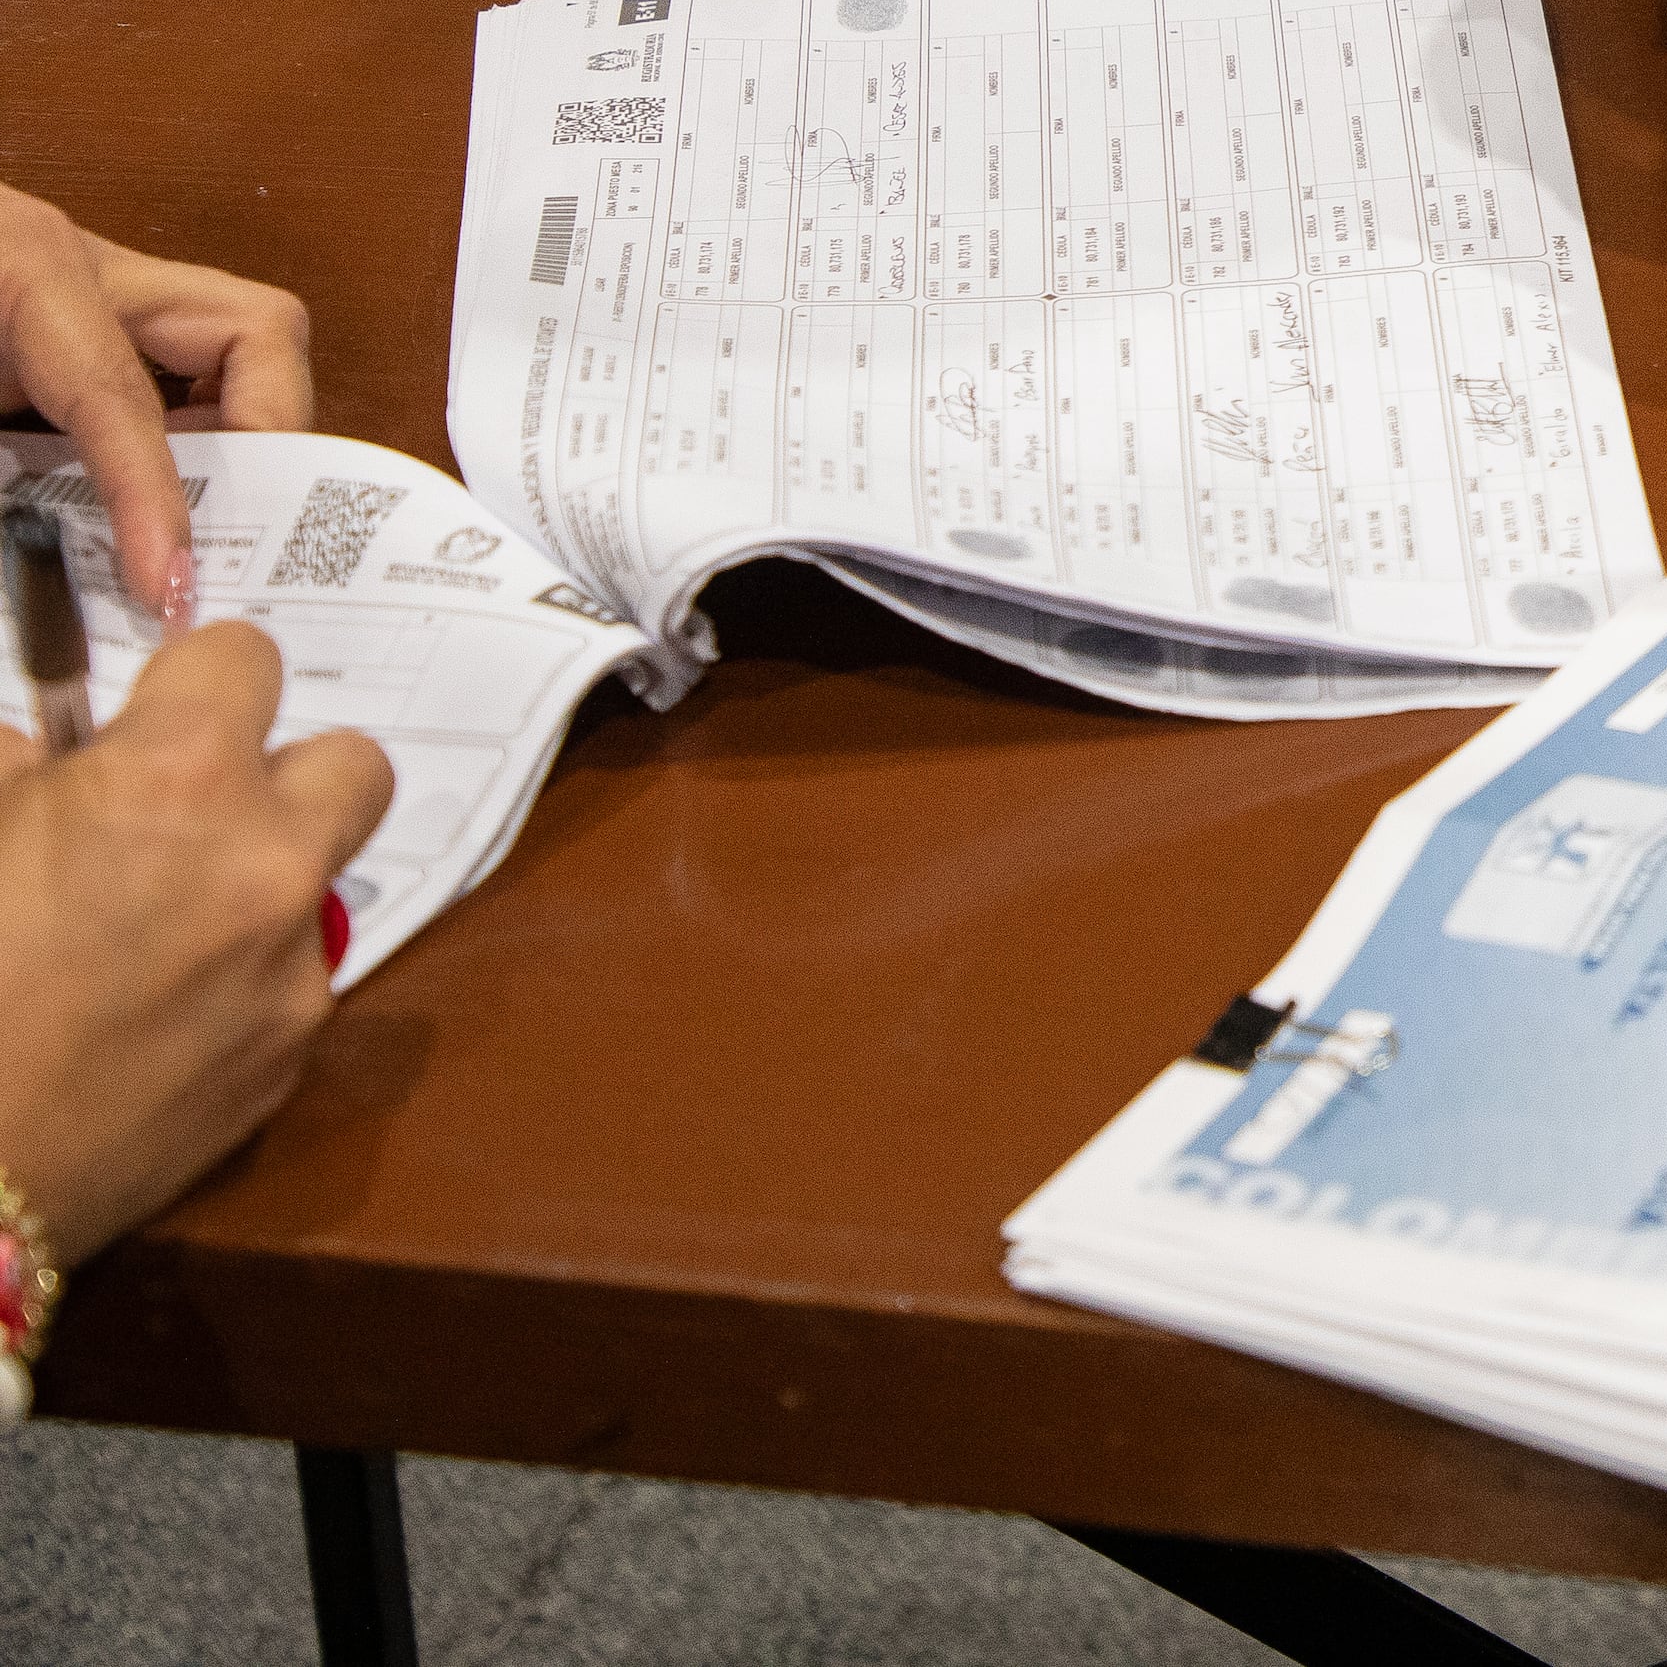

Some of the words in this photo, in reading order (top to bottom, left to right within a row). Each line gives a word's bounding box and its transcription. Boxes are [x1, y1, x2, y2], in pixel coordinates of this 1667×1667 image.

[1342, 42, 1354, 67] NOMBRES
[1457, 32, 1470, 57] NOMBRES
[1108, 64, 1119, 89] NOMBRES
[1226, 55, 1237, 80] NOMBRES
[743, 78, 755, 105] NOMBRES
[867, 78, 878, 104] NOMBRES
[988, 72, 999, 96] NOMBRES
[1412, 86, 1422, 103] FIRMA
[1175, 110, 1185, 127] FIRMA
[1294, 98, 1304, 115] FIRMA
[1470, 104, 1482, 131] APELLIDO
[931, 126, 942, 142] FIRMA
[1054, 118, 1064, 134] FIRMA
[1352, 115, 1364, 142] APELLIDO
[681, 132, 693, 150] FIRMA
[807, 130, 818, 148] FIRMA
[1111, 138, 1122, 165] APELLIDO
[1232, 128, 1244, 154] APELLIDO
[1474, 131, 1487, 159] SEGUNDO
[988, 145, 999, 172] APELLIDO
[1235, 154, 1246, 182] SEGUNDO
[1355, 142, 1367, 170] SEGUNDO
[609, 161, 622, 177] MESA
[737, 155, 750, 183] APELLIDO
[1112, 165, 1124, 192] SEGUNDO
[607, 177, 620, 201] PUESTO
[735, 183, 748, 209] SEGUNDO
[863, 180, 874, 206] SEGUNDO
[989, 173, 999, 199] SEGUNDO
[604, 202, 617, 217] ZONA
[1362, 199, 1374, 228] APELLIDO
[1427, 203, 1440, 226] CÉDULA
[1483, 189, 1497, 216] APELLIDO
[1114, 222, 1126, 249] APELLIDO
[1180, 226, 1193, 249] CÉDULA
[1239, 211, 1251, 239] APELLIDO
[1305, 214, 1318, 238] CÉDULA
[1488, 217, 1500, 240] PRIMER
[730, 238, 743, 264] APELLIDO
[860, 234, 872, 261] APELLIDO
[989, 229, 1000, 256] APELLIDO
[1055, 235, 1067, 258] CÉDULA
[1241, 239, 1253, 263] PRIMER
[1365, 228, 1377, 251] PRIMER
[1552, 235, 1571, 266] 115,964
[668, 247, 681, 269] CÉDULA
[799, 245, 812, 267] CÉDULA
[928, 242, 940, 264] CÉDULA
[1116, 250, 1127, 272] PRIMER
[728, 264, 741, 285] PRIMER
[859, 262, 871, 283] PRIMER
[989, 257, 1000, 279] PRIMER
[1558, 269, 1574, 283] KIT
[1375, 317, 1389, 348] NOMBRES
[1502, 306, 1515, 336] NOMBRES
